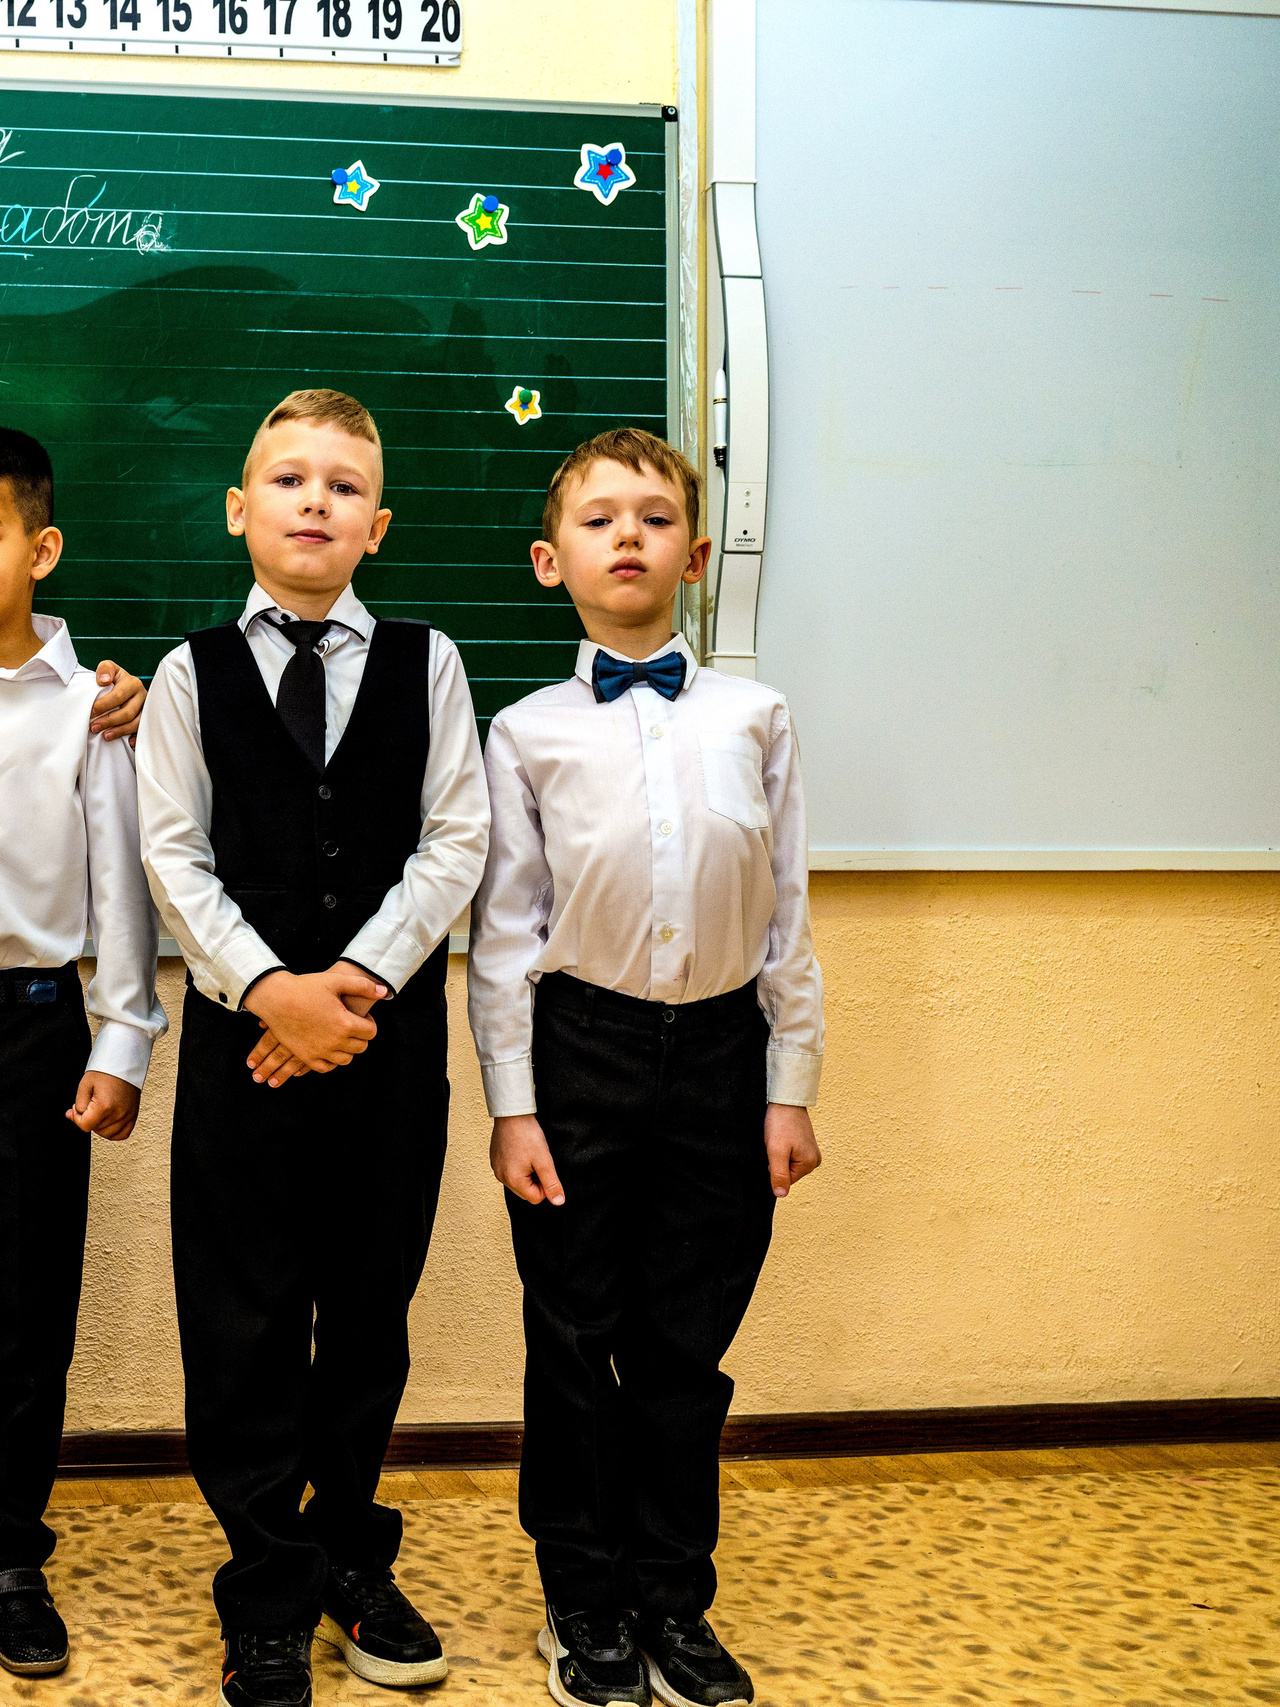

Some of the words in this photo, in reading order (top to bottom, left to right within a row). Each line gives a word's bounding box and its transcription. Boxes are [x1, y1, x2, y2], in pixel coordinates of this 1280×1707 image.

[0, 0, 37, 28] 12
[48, 0, 87, 29] 13
[102, 0, 141, 31] 14
[157, 0, 193, 32] 15
[213, 0, 248, 35] 16
[264, 0, 298, 36] 17
[318, 0, 352, 38] 18
[368, 0, 403, 40] 19
[421, 0, 461, 43] 20
